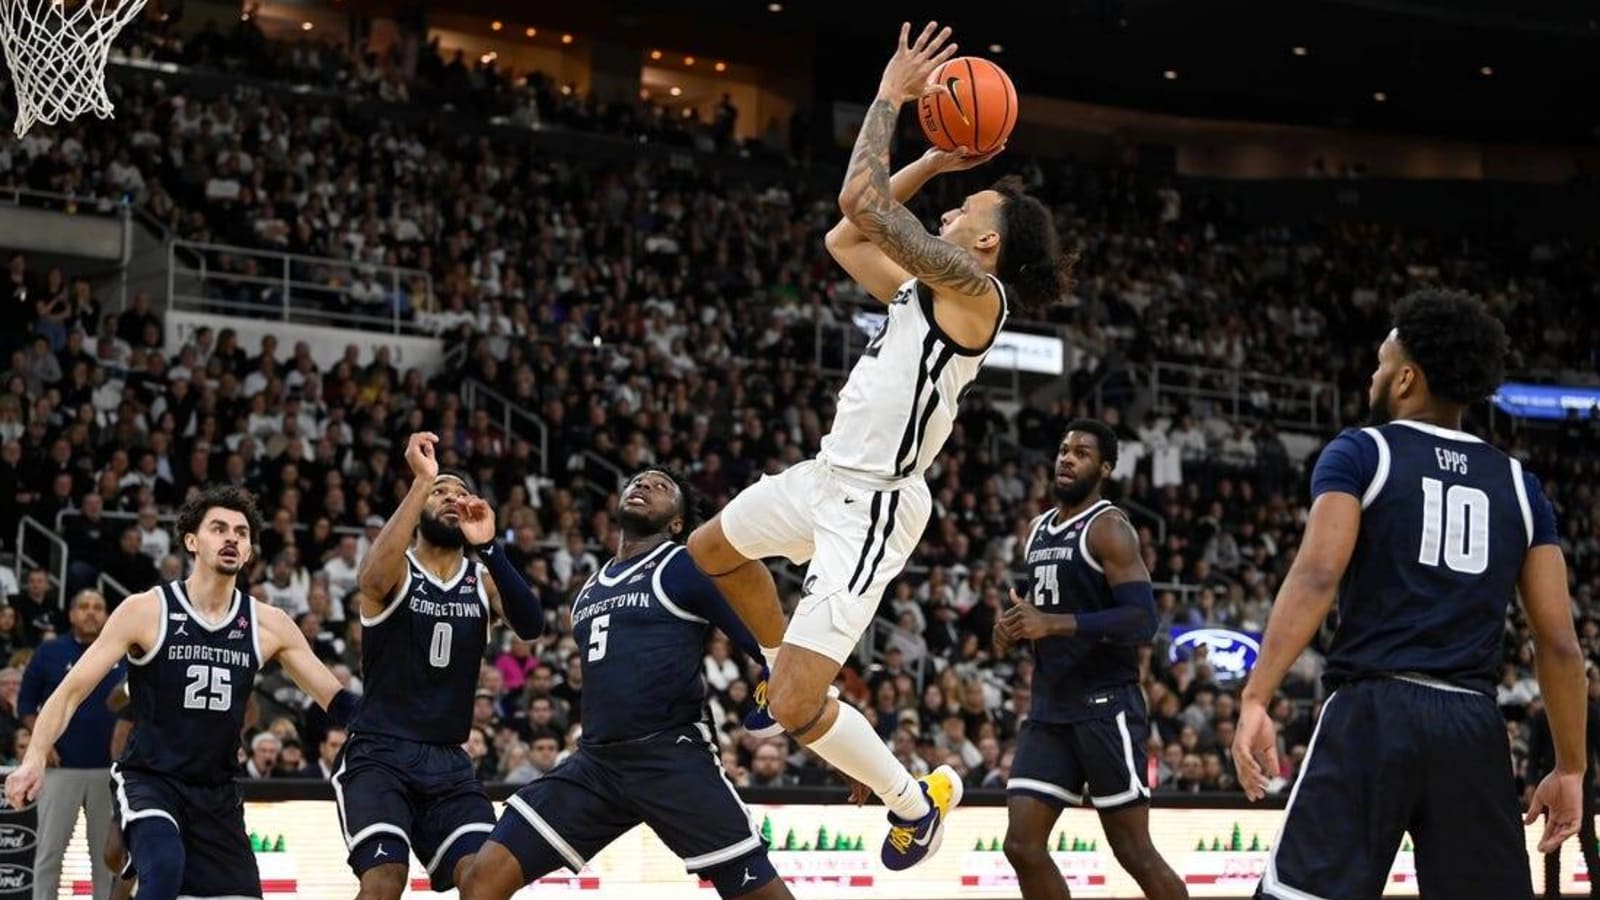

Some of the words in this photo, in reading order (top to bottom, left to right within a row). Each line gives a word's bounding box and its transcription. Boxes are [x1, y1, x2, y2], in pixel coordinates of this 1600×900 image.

[1434, 447, 1468, 475] EPPS
[1418, 476, 1489, 575] 10
[1034, 564, 1059, 606] 24
[573, 592, 650, 626] EORGETOWN
[168, 645, 250, 668] GEORGETOWN
[429, 621, 453, 668] 0
[587, 613, 611, 662] 5
[183, 664, 232, 711] 25
[0, 828, 25, 848] ord
[0, 868, 25, 888] ord
